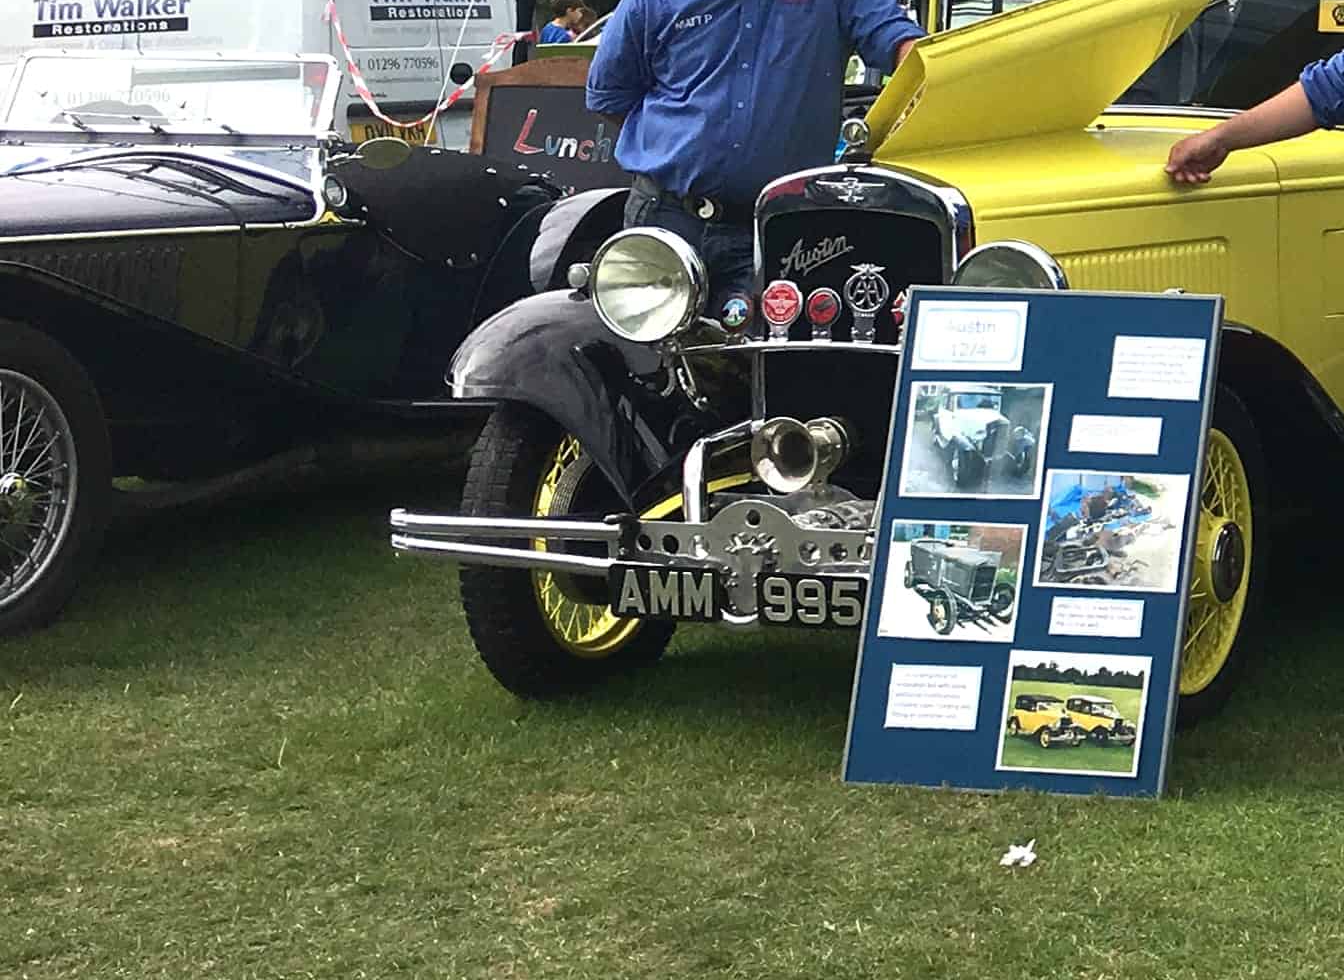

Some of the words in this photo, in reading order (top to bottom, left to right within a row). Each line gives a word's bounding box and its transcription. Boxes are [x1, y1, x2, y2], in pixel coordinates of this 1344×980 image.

[388, 7, 479, 19] Restorations
[51, 21, 169, 36] Restorations
[368, 58, 401, 72] 01296
[513, 108, 612, 163] Lunch
[780, 235, 854, 278] Austin
[617, 569, 714, 618] AMM
[762, 576, 861, 626] 995
